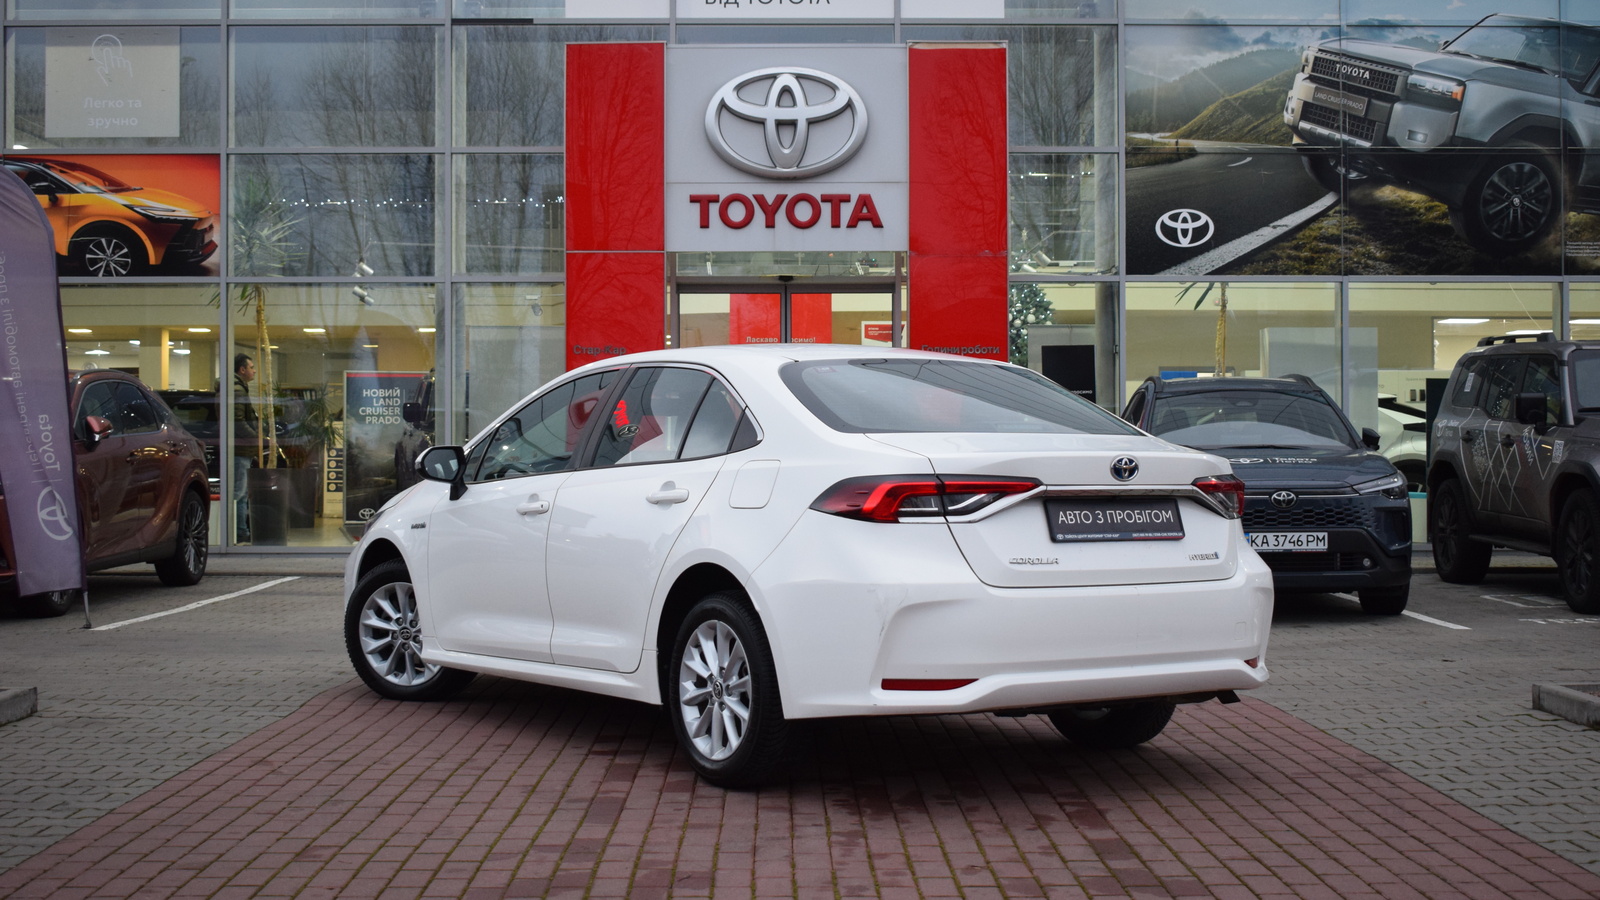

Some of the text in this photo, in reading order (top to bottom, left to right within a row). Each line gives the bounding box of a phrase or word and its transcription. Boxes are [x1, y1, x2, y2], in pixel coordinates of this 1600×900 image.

[1336, 64, 1370, 79] TOYOTA
[83, 97, 142, 108] Легко та
[1314, 92, 1327, 100] LAND
[1347, 100, 1363, 110] PRADO
[88, 117, 138, 129] зручно
[689, 193, 884, 229] TOYOTA
[573, 345, 627, 356] Стар-Кар
[962, 344, 1000, 356] роботи
[362, 387, 401, 397] НОВИЙ
[373, 398, 401, 406] LAND
[359, 407, 401, 416] CRUISER
[366, 416, 401, 425] PRADO
[1058, 510, 1174, 524] АВТО З ПРОБІГОМ
[1250, 534, 1326, 547] KA 3746 PM
[1009, 556, 1059, 565] COROLLA
